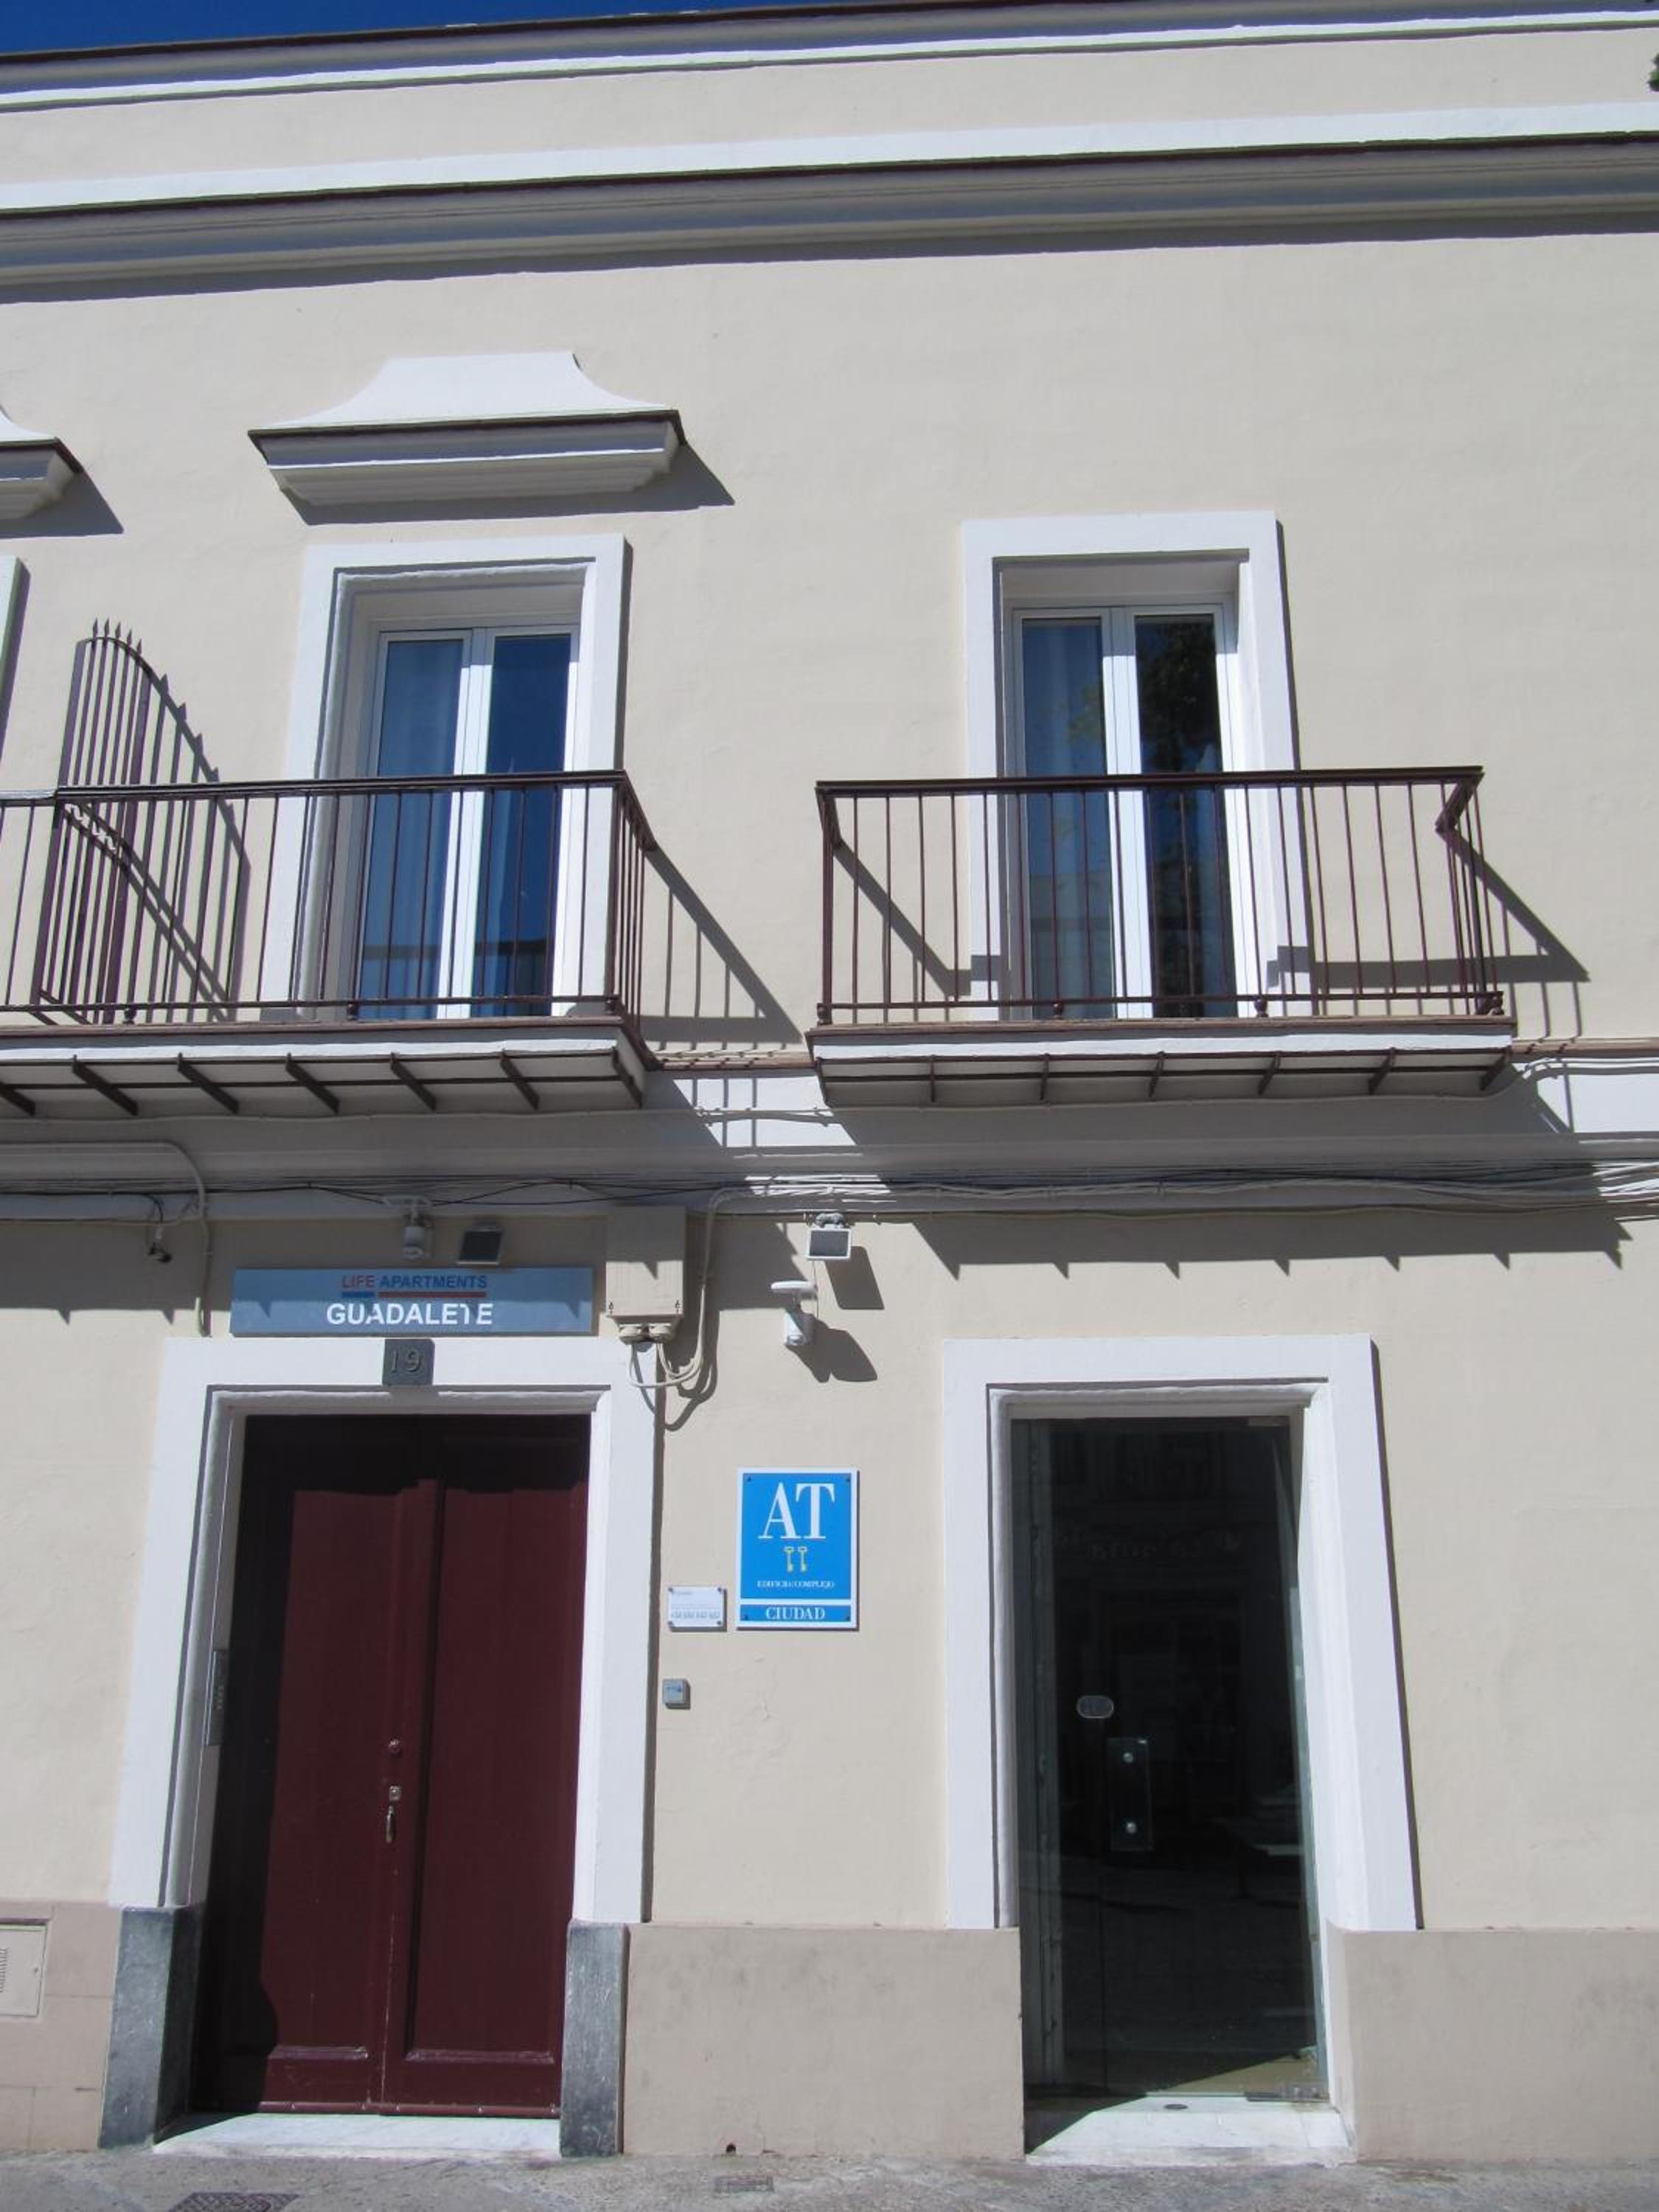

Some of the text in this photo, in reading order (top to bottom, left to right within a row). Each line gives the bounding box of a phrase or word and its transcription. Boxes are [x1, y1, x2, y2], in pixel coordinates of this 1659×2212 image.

[342, 1275, 487, 1289] LIFE APARTMENTS
[391, 1348, 423, 1373] 19
[757, 1482, 835, 1539] AT
[765, 1607, 826, 1621] CIUDAD
